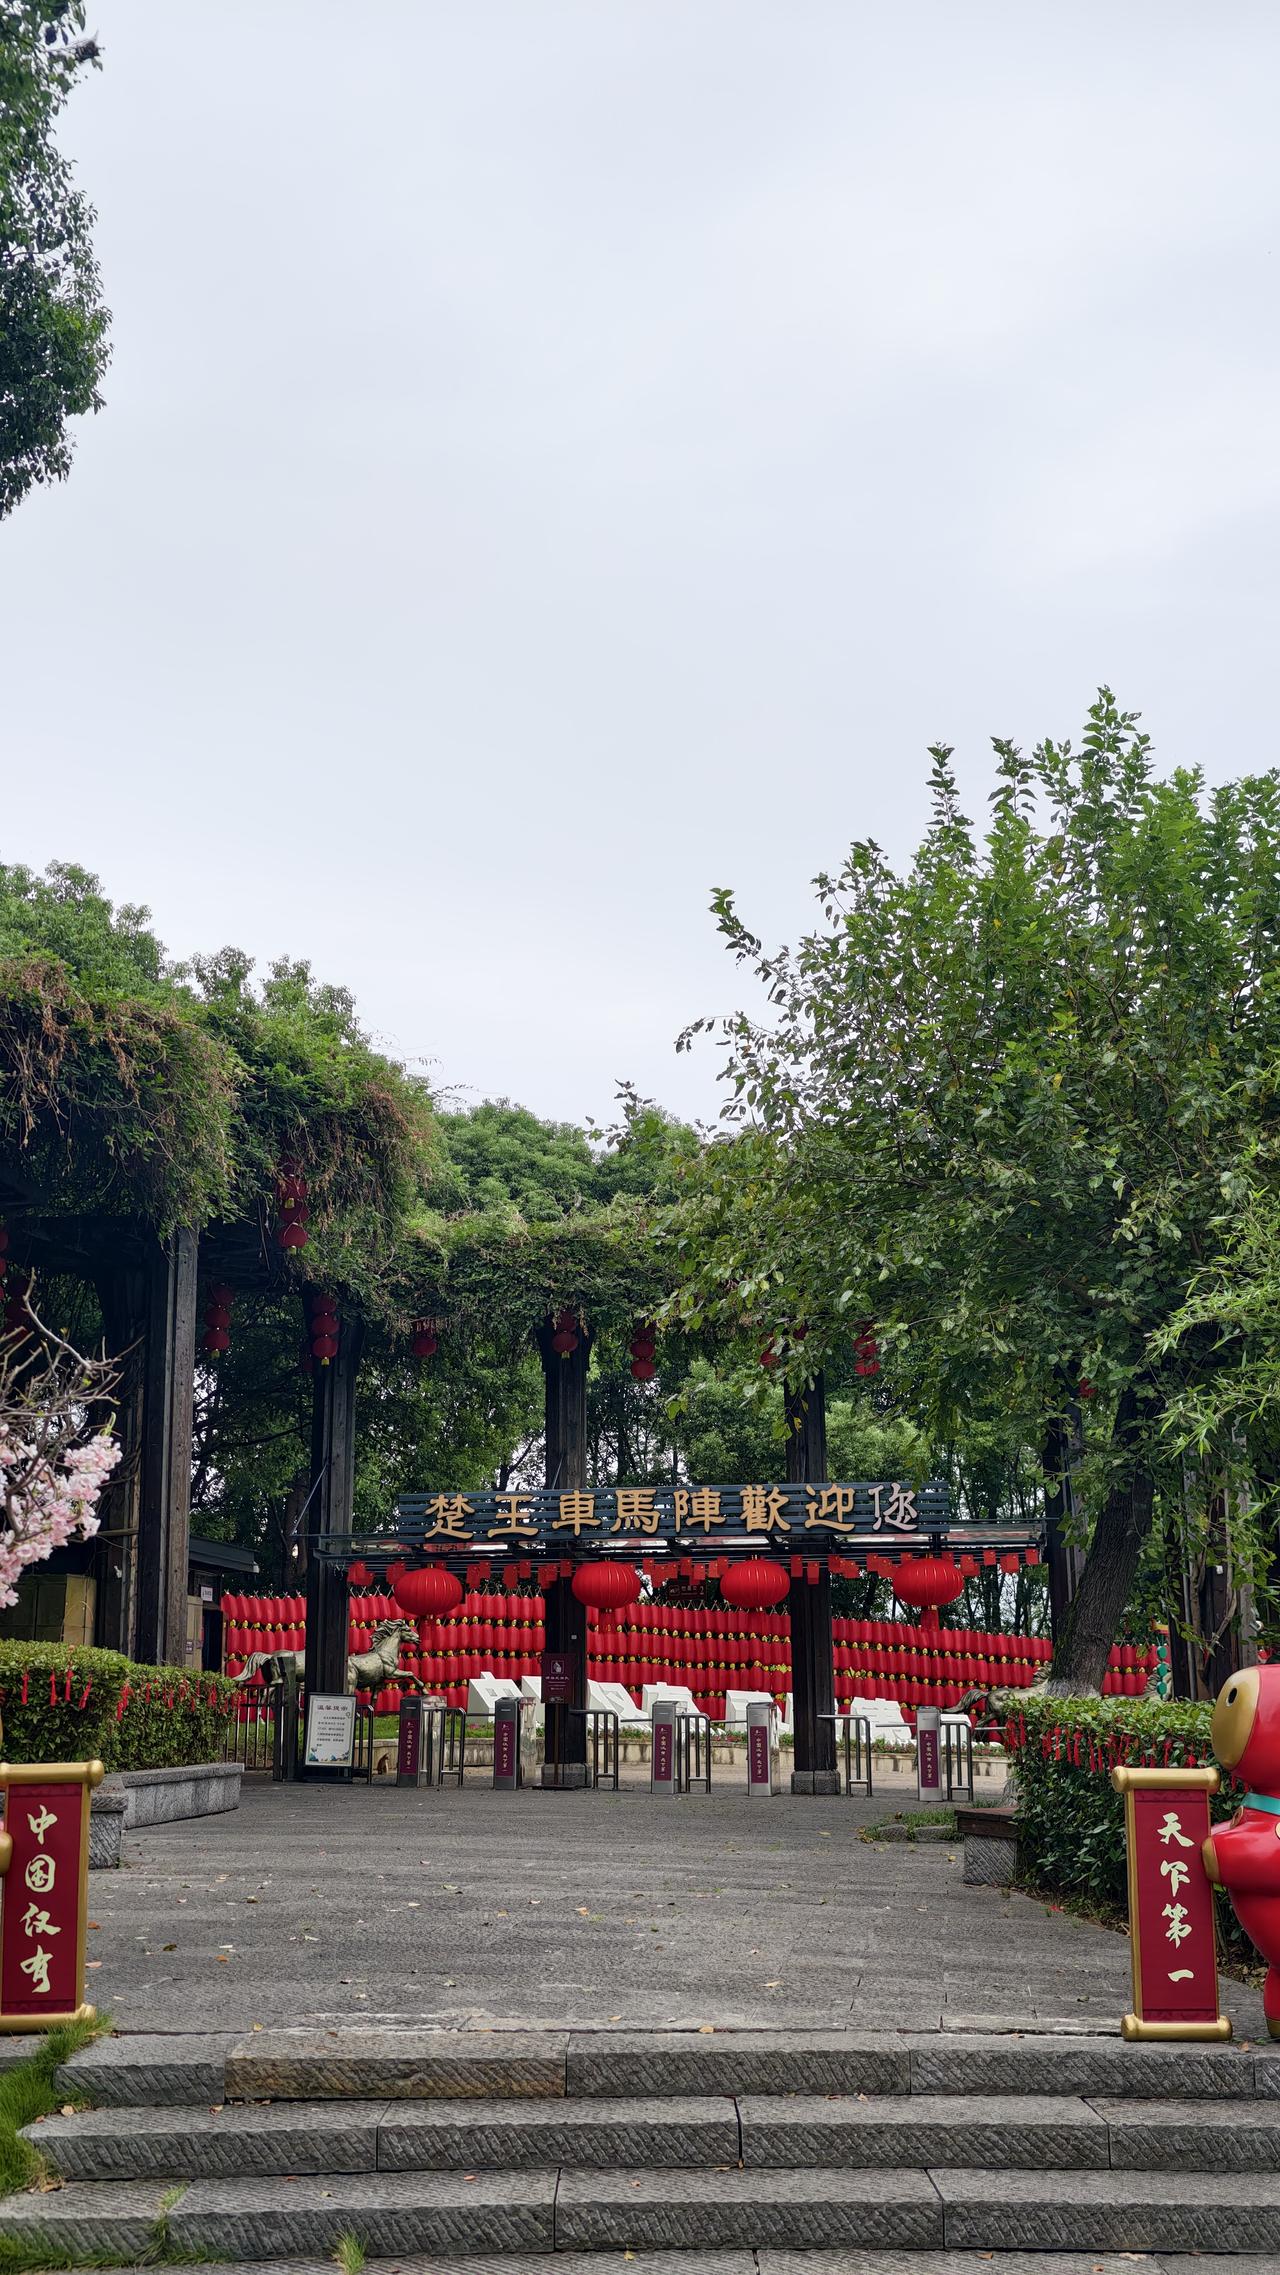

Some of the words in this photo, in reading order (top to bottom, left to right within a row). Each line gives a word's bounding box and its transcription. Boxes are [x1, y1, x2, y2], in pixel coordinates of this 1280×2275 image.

[20, 1804, 62, 1994] 中国仅有
[1156, 1811, 1195, 1983] 天下第一
